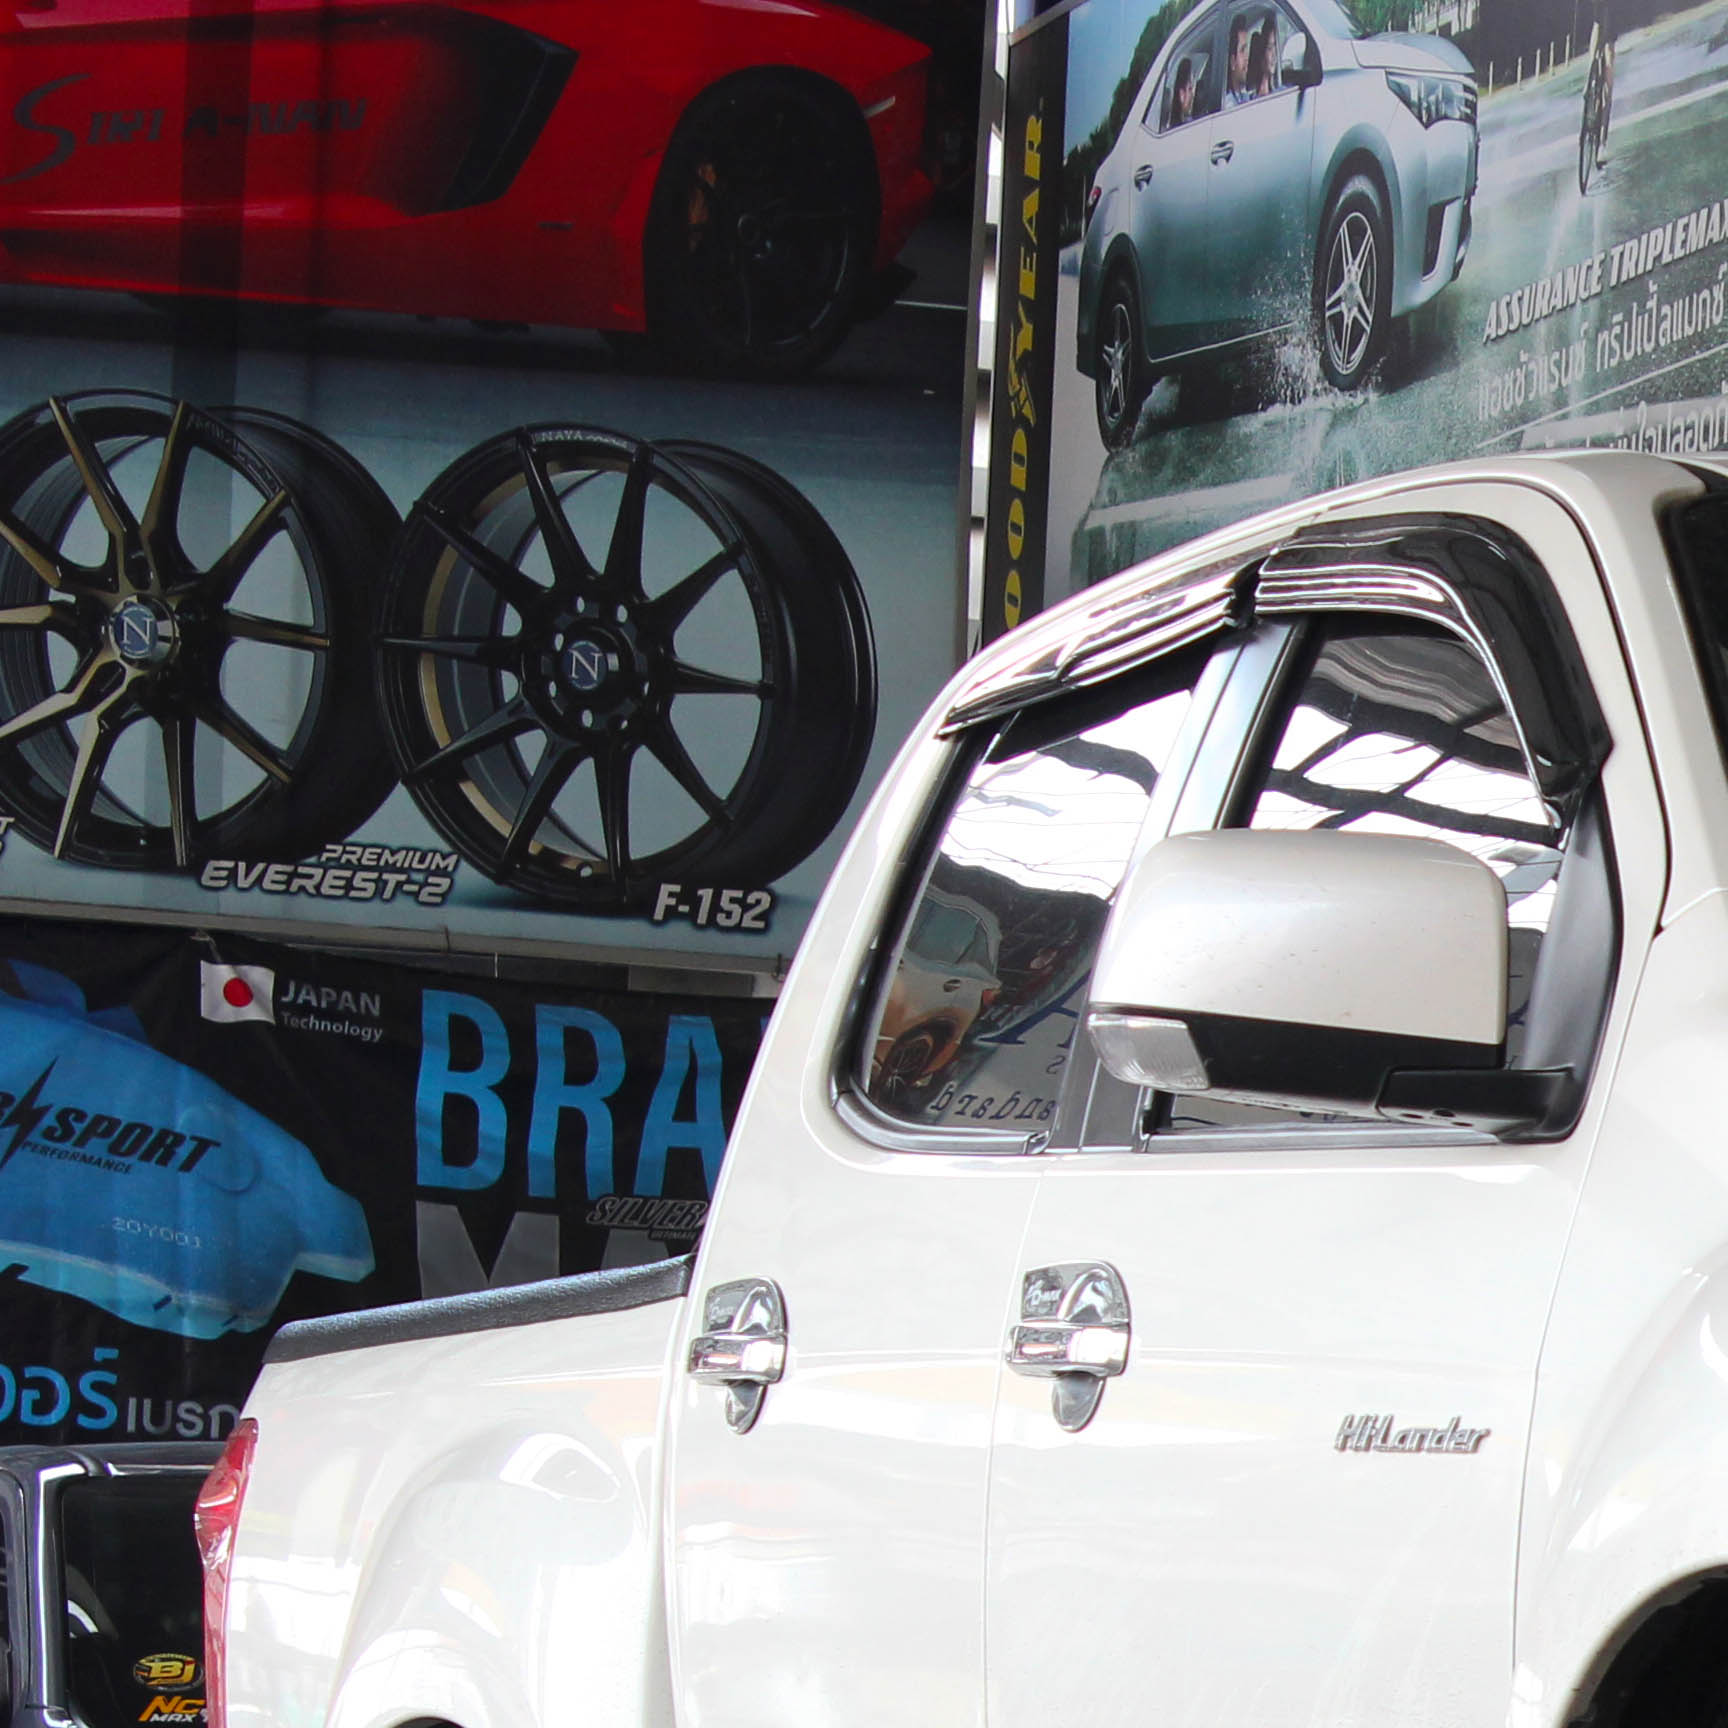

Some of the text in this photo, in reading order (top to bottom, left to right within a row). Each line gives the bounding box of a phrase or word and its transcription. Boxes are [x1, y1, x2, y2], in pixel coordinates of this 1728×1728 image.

[1482, 252, 1606, 346] ASSURANCE
[1003, 112, 1044, 630] OODYEAR
[320, 844, 458, 872] PREMIUM
[200, 860, 452, 905] EVEREST-2
[652, 881, 774, 931] F-152
[281, 978, 382, 1018] JAPAN
[281, 1010, 384, 1043] Technology
[415, 988, 768, 1199] BRA
[20, 1140, 134, 1175] PERFORMANCE
[42, 1106, 222, 1174] SPORT
[137, 1694, 207, 1724] NC
